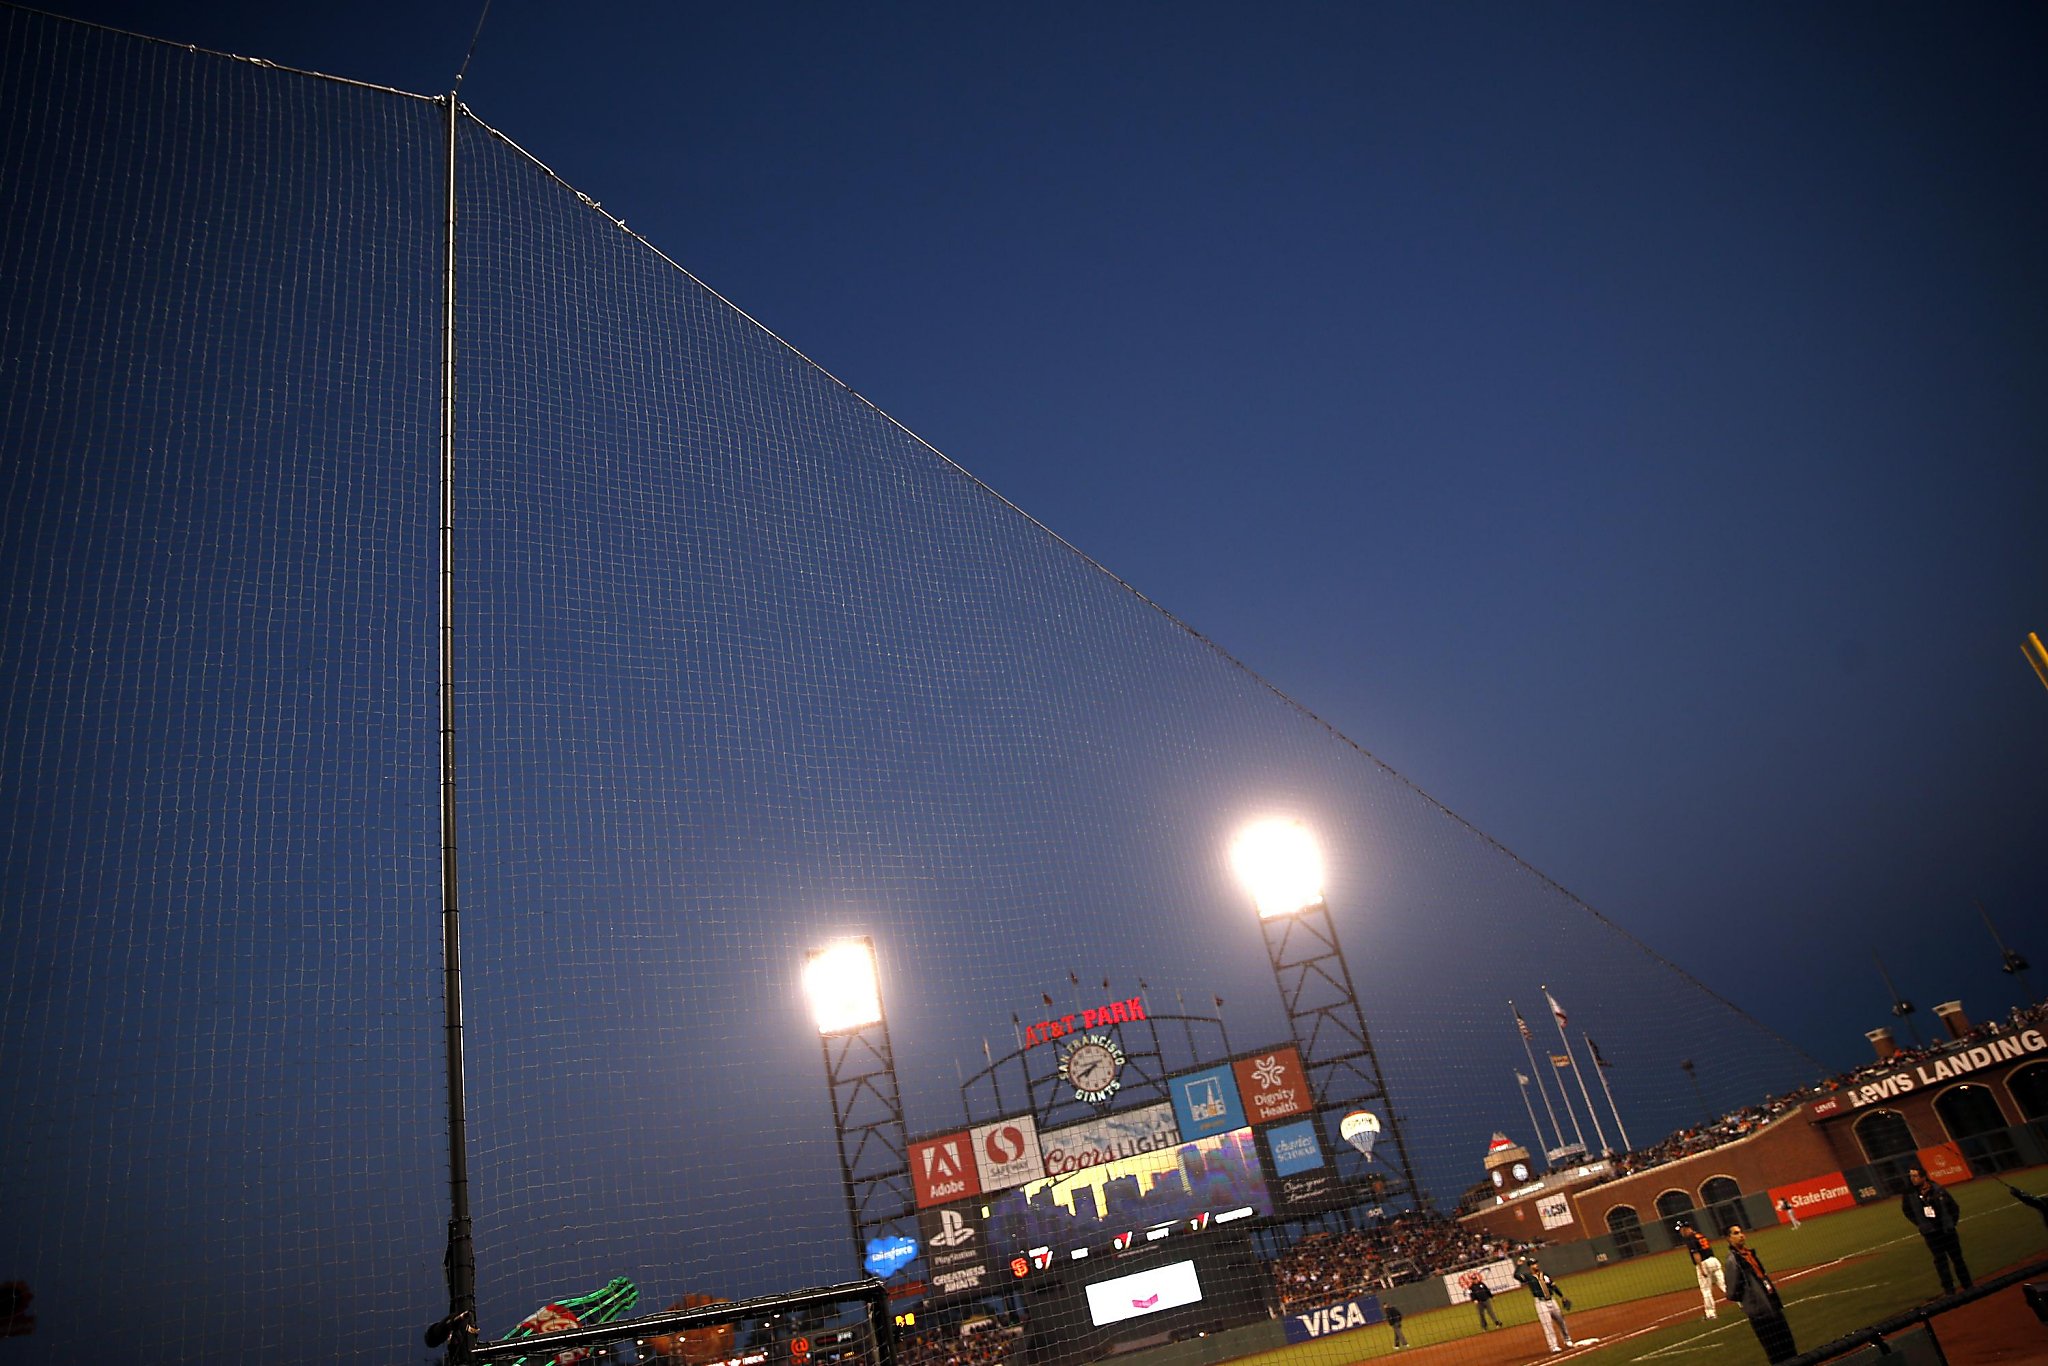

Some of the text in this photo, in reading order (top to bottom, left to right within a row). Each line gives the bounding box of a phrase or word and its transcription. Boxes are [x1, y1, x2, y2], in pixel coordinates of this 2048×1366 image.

[1025, 996, 1146, 1051] AT&T PARK
[1058, 1034, 1126, 1080] SAN FRANCISCO
[1916, 1029, 2048, 1085] LANDING
[1075, 1079, 1121, 1102] GIANTS
[1254, 1088, 1295, 1106] Dignity
[1260, 1100, 1298, 1118] Health
[1045, 1129, 1181, 1176] Coors LIGHT
[930, 1180, 965, 1198] Adobe
[1550, 1202, 1567, 1217] CSN
[932, 1265, 986, 1286] GREATNESS
[944, 1276, 980, 1293] AWAITS
[1296, 1302, 1366, 1337] VISA
